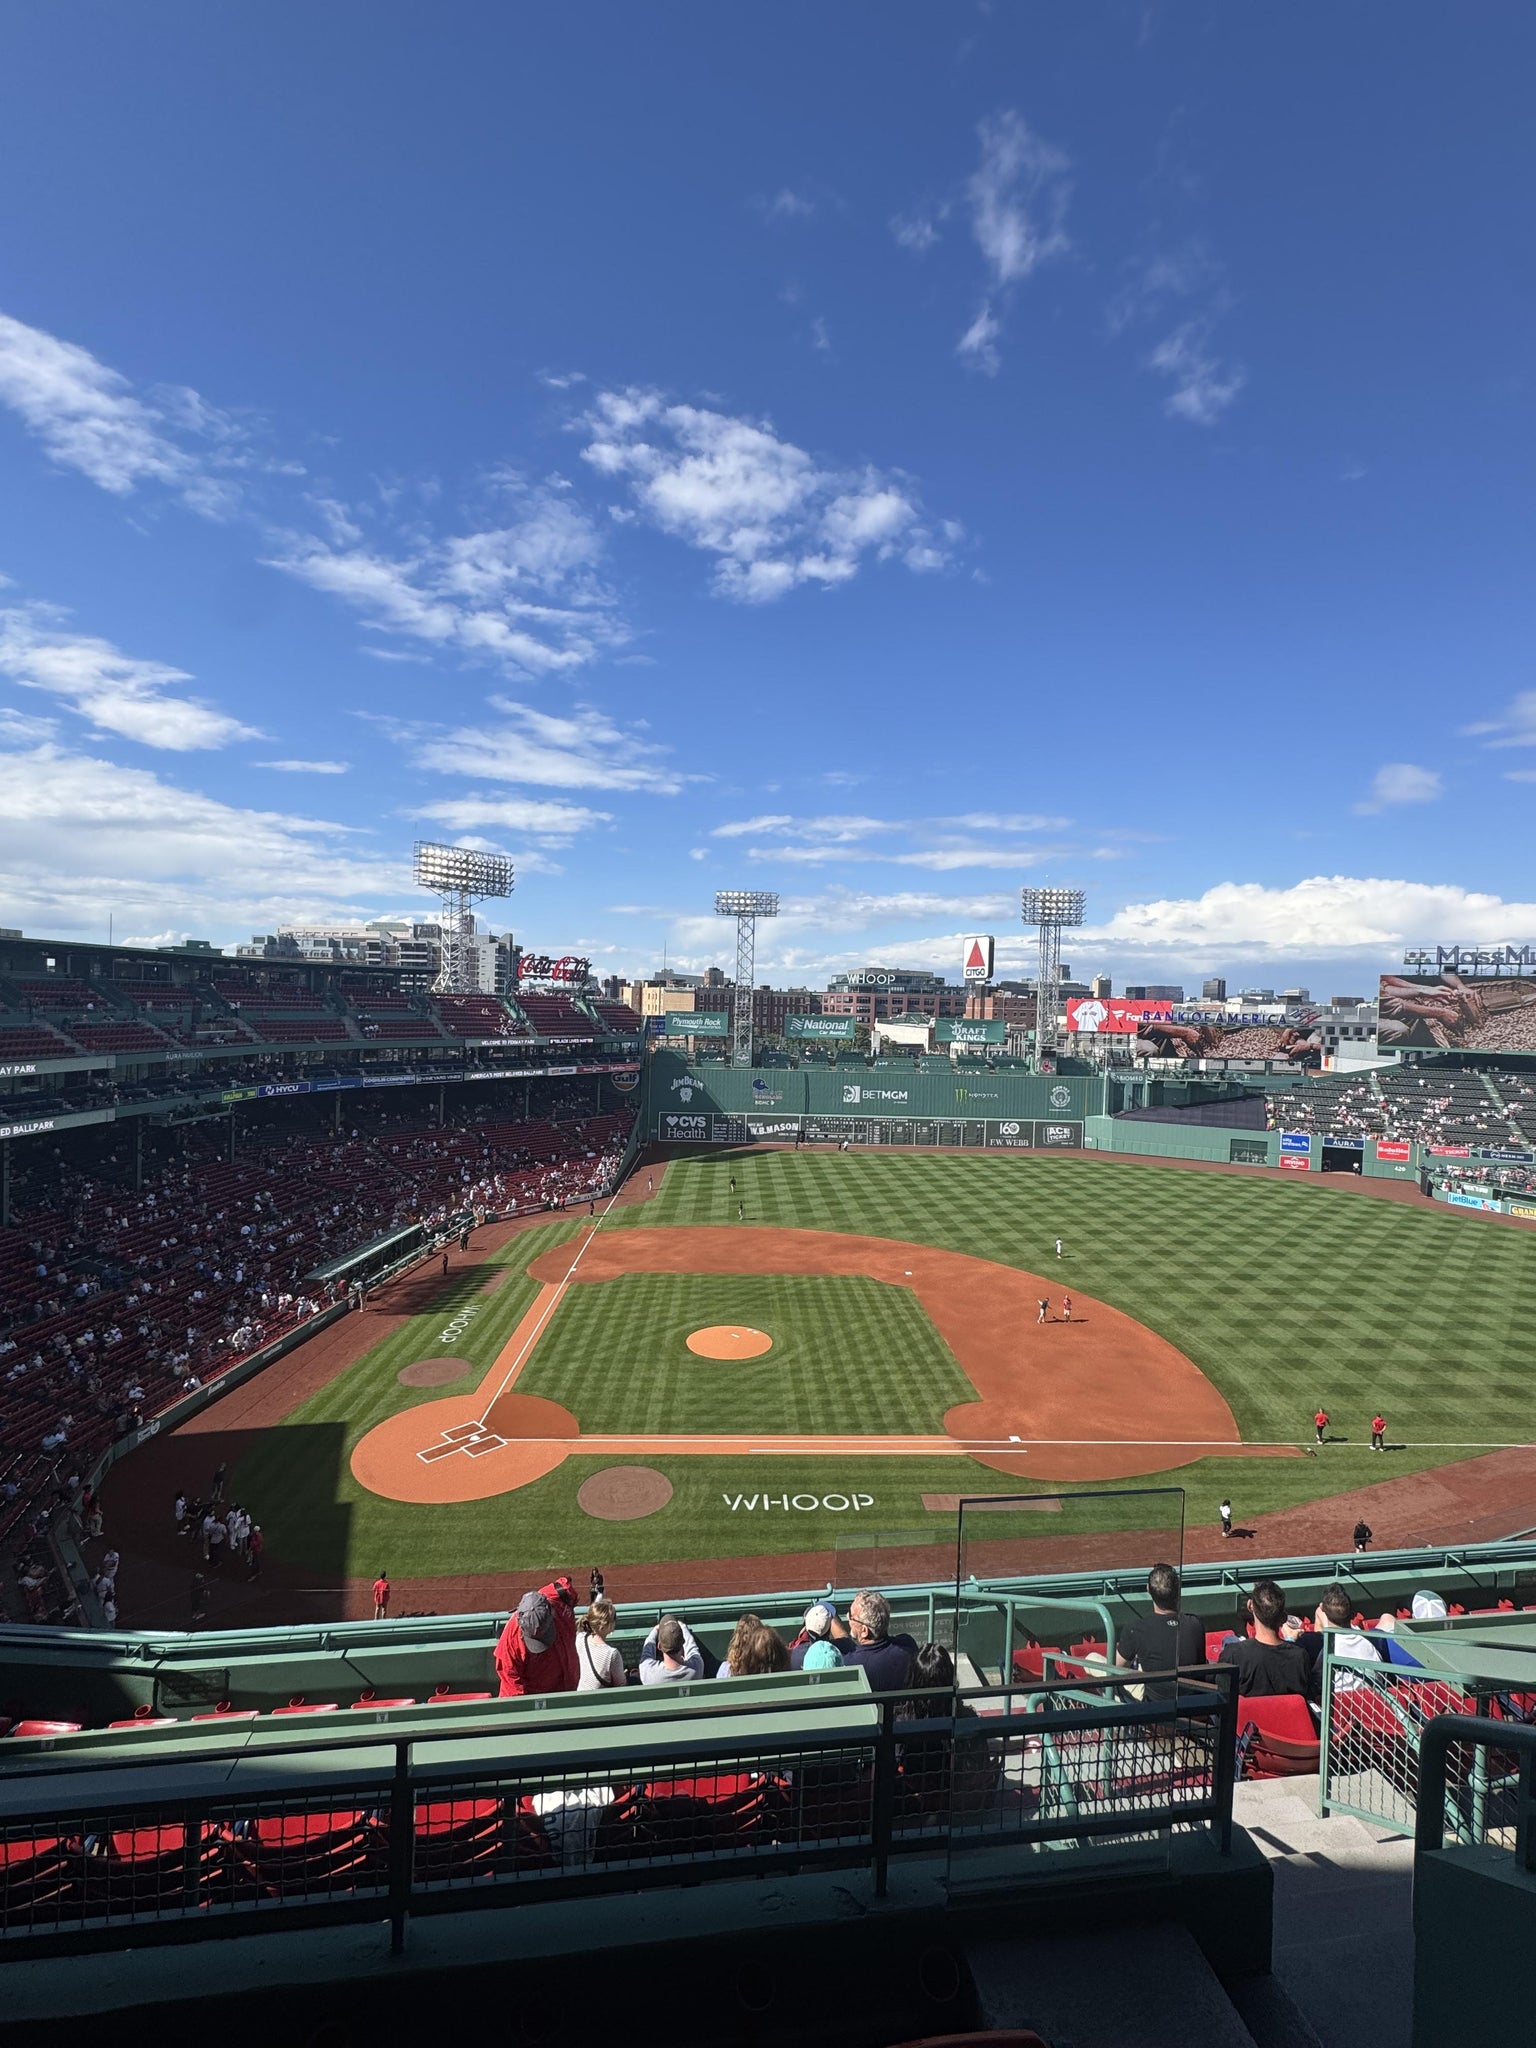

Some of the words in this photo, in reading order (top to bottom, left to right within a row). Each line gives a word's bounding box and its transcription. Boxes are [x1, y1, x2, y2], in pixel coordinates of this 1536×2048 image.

[846, 971, 896, 984] WHOOP
[966, 968, 985, 976] CITGO
[672, 1017, 703, 1026] Plymouth
[704, 1018, 721, 1026] Rock
[1143, 1010, 1184, 1021] BANK
[1191, 1012, 1211, 1023] OF
[1214, 1012, 1287, 1024] AMERICA
[804, 1019, 849, 1030] National
[951, 1027, 987, 1036] DRAFT
[956, 1034, 986, 1042] KINGS
[14, 1064, 36, 1074] PARK
[612, 1073, 637, 1082] Gulf
[276, 1085, 298, 1093] HYCU
[862, 1089, 908, 1100] BETMGM
[679, 1116, 707, 1127] CVS
[13, 1120, 55, 1135] BALLPARK
[667, 1127, 706, 1139] Health
[1000, 1122, 1020, 1135] 160
[1049, 1127, 1071, 1135] ACE
[1004, 1139, 1029, 1147] WEBB
[1452, 1195, 1478, 1206] jetBlue
[437, 1304, 483, 1343] WHOOP
[722, 1493, 874, 1511] WHOOP
